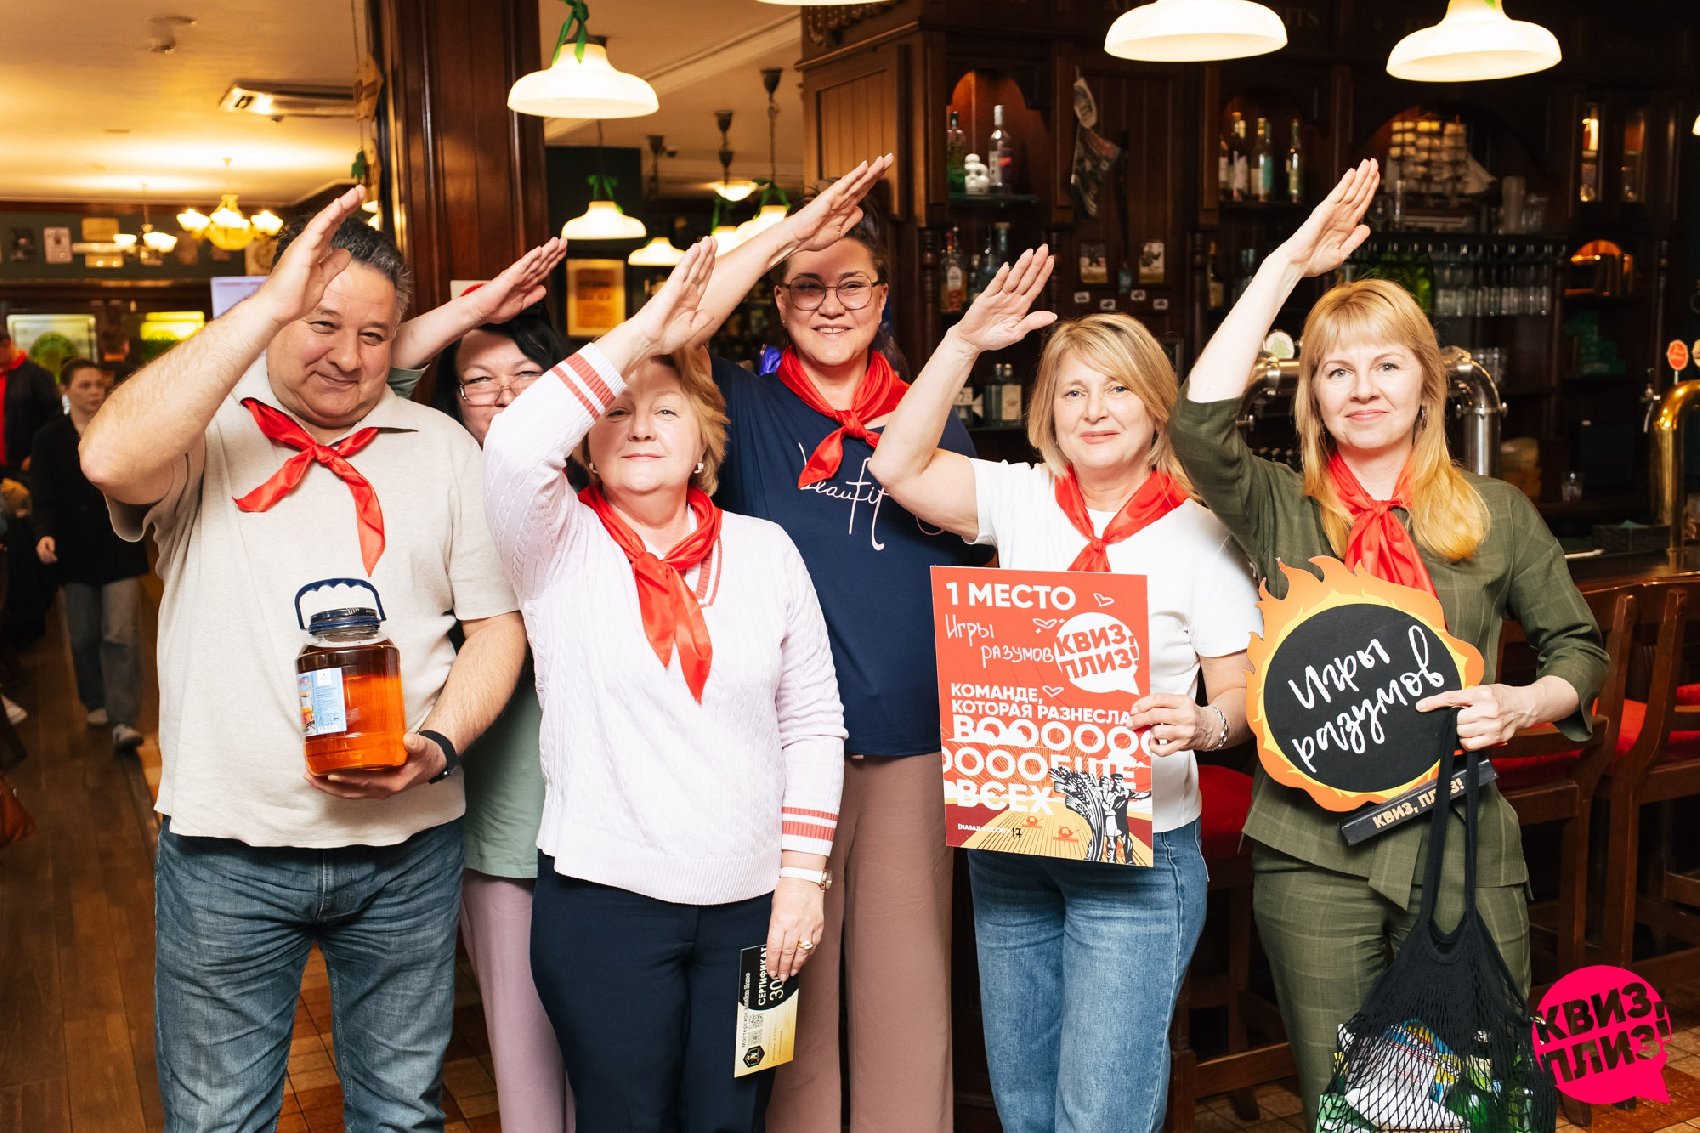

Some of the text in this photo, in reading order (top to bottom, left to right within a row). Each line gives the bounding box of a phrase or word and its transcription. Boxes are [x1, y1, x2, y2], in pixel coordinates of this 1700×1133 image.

[946, 582, 1077, 611] 1 МЕСТО
[945, 614, 995, 647] Игры
[981, 644, 1055, 669] разумов
[1288, 639, 1391, 709] Игры
[951, 683, 1043, 704] КОМАНДЕ,
[1291, 625, 1445, 773] разумов
[952, 699, 1131, 726] КОТОРАЯ РАЗНЕСЛА
[956, 779, 1054, 816] ВСЕХ
[1372, 777, 1465, 829] КВИЗ, ПЛЗ!
